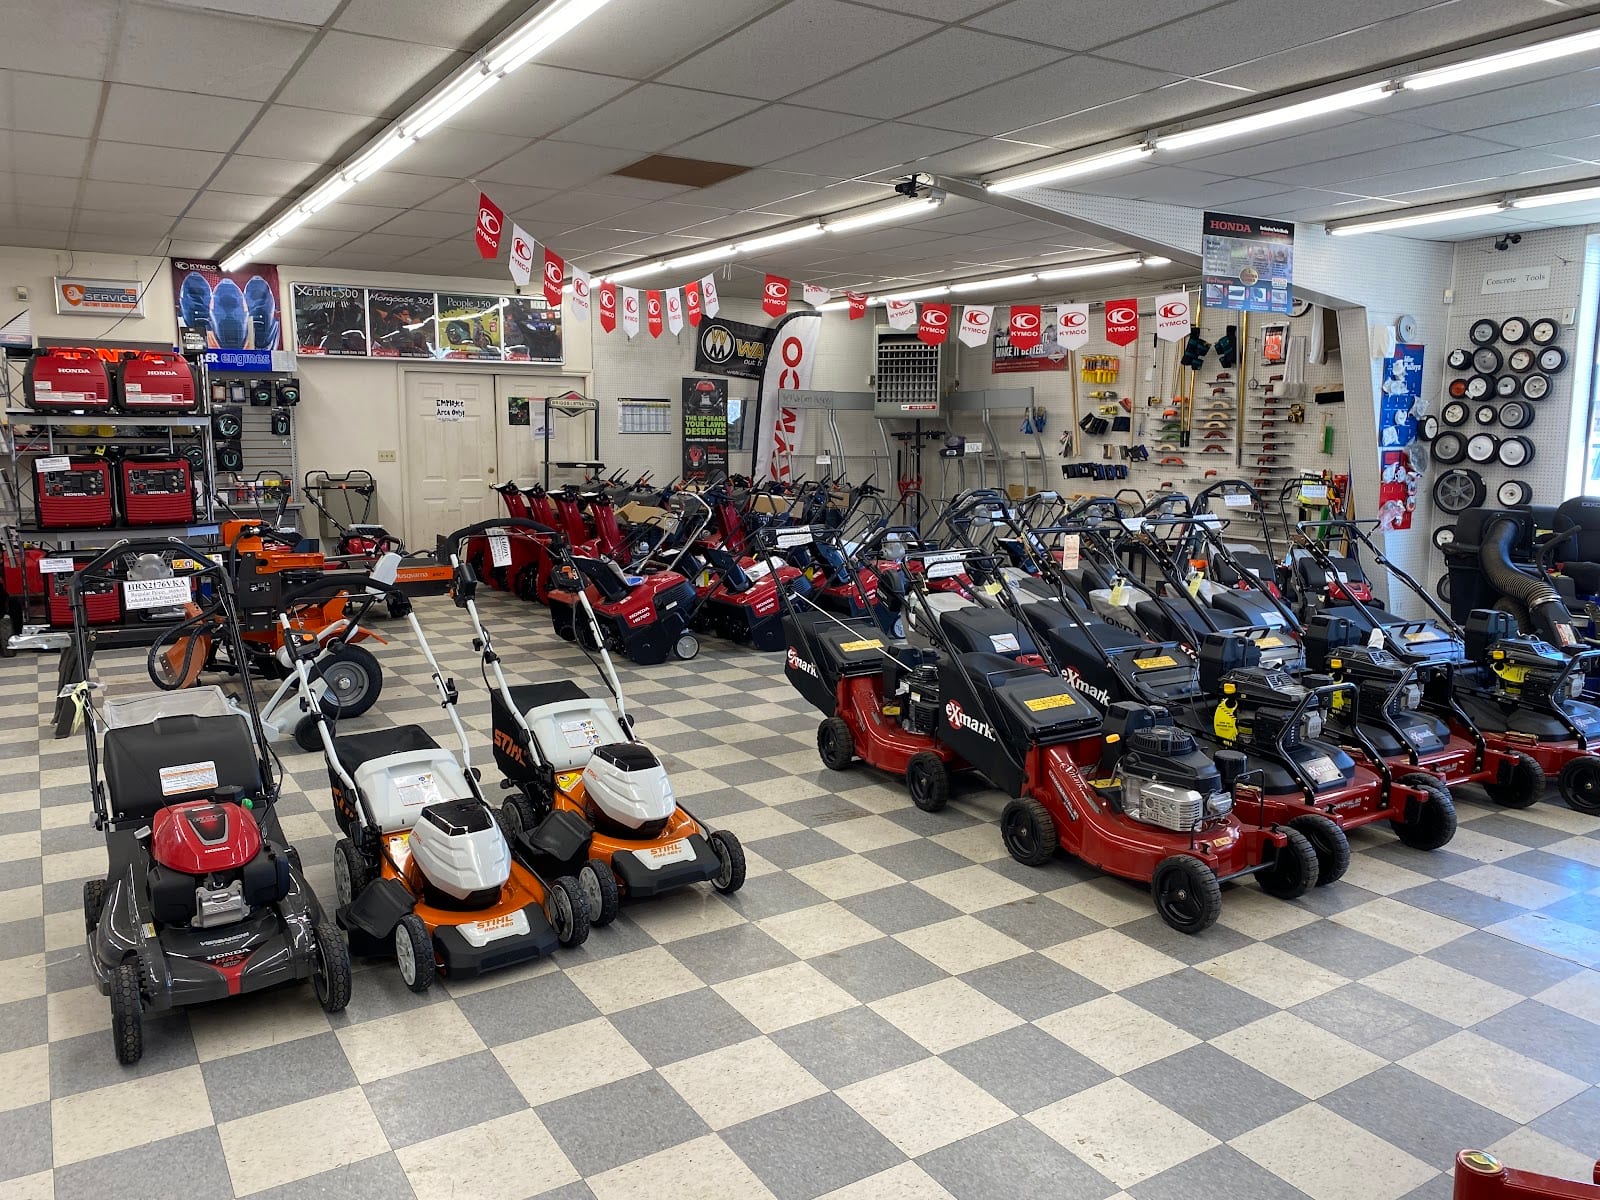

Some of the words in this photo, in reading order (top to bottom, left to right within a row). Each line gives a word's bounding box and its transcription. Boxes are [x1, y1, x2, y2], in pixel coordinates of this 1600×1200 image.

[1210, 220, 1252, 233] HONDA
[477, 225, 497, 248] KYMCO
[190, 263, 217, 271] KYMCO
[512, 256, 530, 274] KYMCO
[1525, 273, 1546, 282] Tools
[340, 287, 359, 299] 500
[544, 280, 563, 296] KYMCO
[85, 293, 137, 303] SERVICE
[369, 293, 414, 306] Mongoose
[418, 296, 435, 306] 300
[447, 297, 474, 309] People
[476, 300, 491, 309] 150
[764, 298, 786, 307] KYMCO
[600, 307, 615, 319] KYMCO
[890, 308, 914, 318] KYMCO
[1107, 325, 1137, 333] KYMCO
[1159, 318, 1188, 328] KYMCO
[919, 325, 946, 335] KYMCO
[961, 325, 988, 335] KYMCO
[1059, 328, 1087, 337] KYMCO
[995, 346, 1013, 358] MAKE
[1014, 346, 1020, 356] IT
[220, 353, 271, 366] engines
[685, 427, 727, 436] DESERVES
[397, 572, 429, 580] usqvarna
[756, 597, 775, 609] HONDA
[629, 606, 650, 620] HONDA
[204, 846, 232, 854] HONDA
[650, 844, 683, 856] STIHL
[476, 914, 515, 930] STIHL
[206, 947, 252, 961] HONDA
